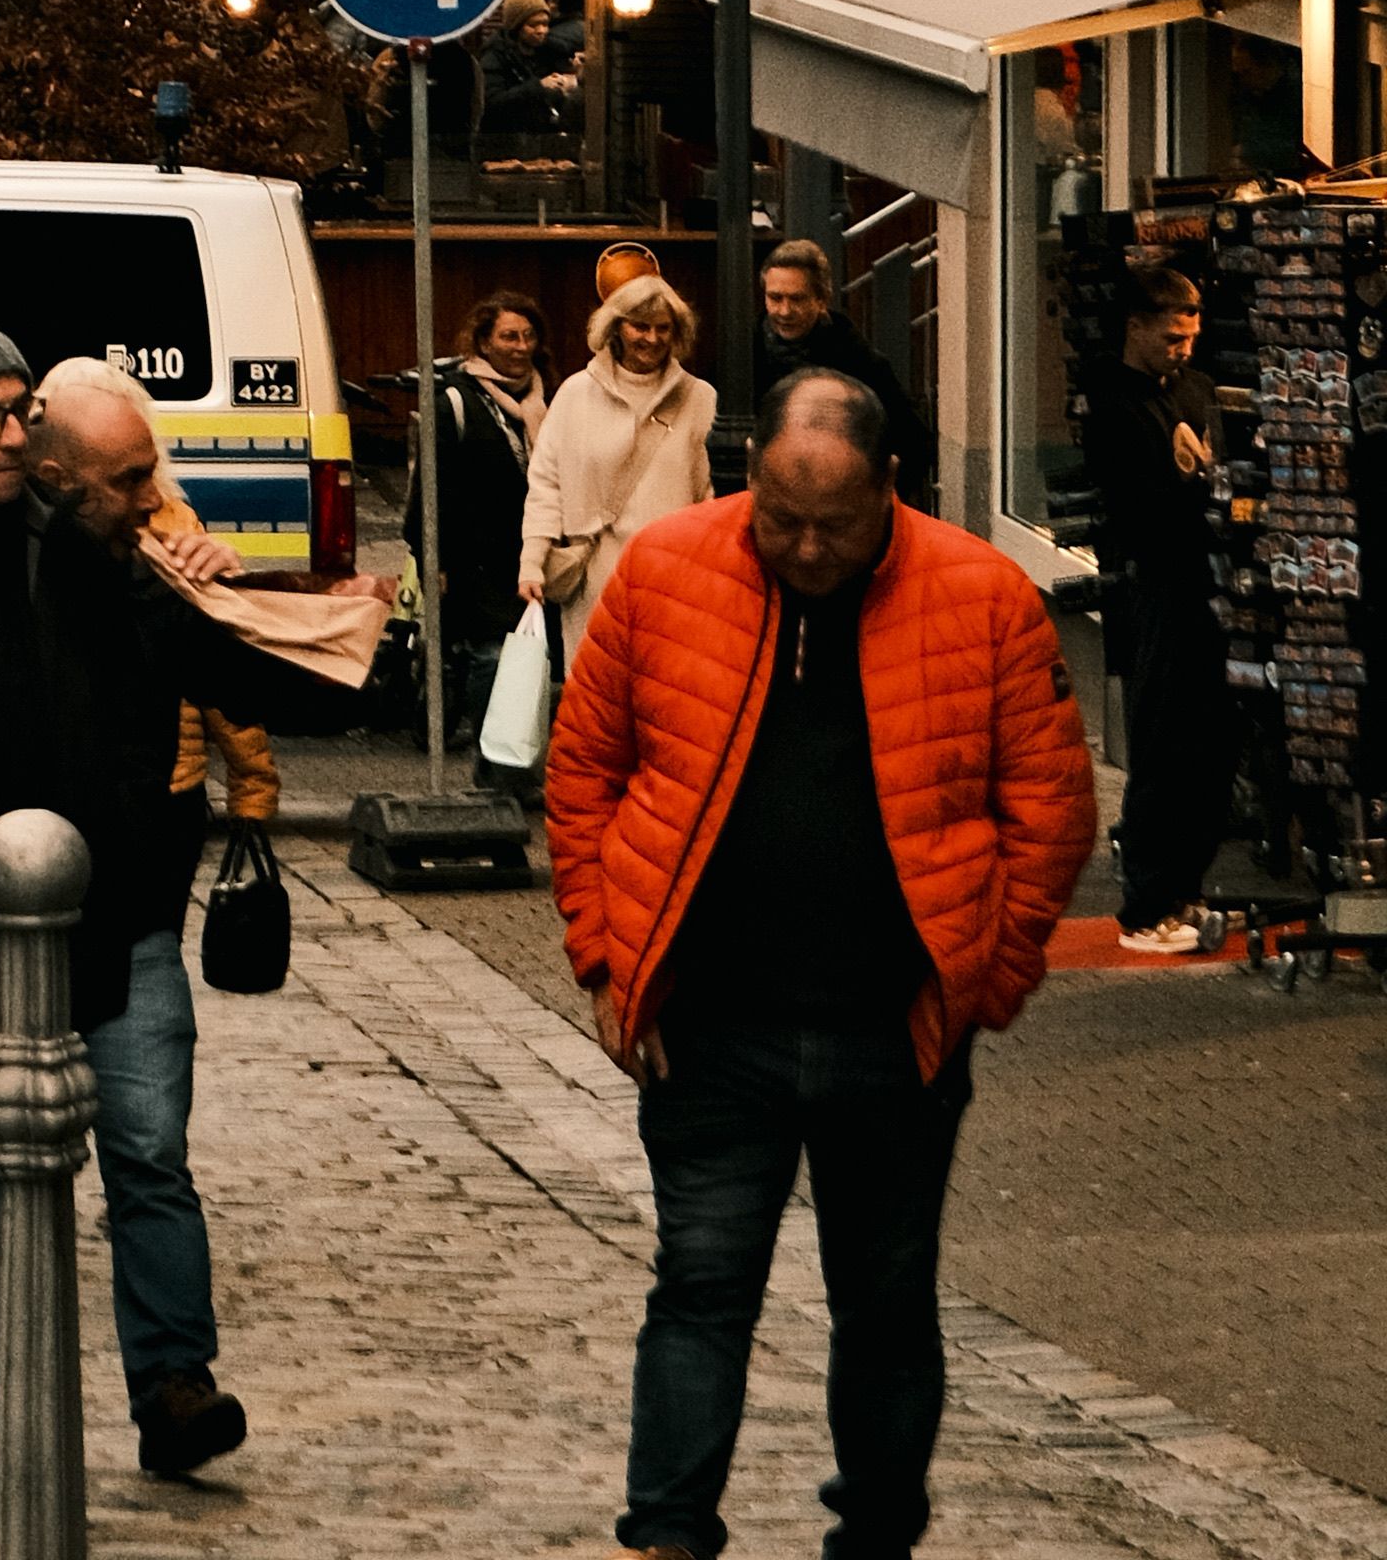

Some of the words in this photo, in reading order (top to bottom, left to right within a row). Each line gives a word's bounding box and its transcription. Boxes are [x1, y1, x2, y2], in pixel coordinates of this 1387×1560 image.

[138, 347, 184, 379] 110
[250, 363, 279, 381] BY
[238, 385, 294, 401] 4422
